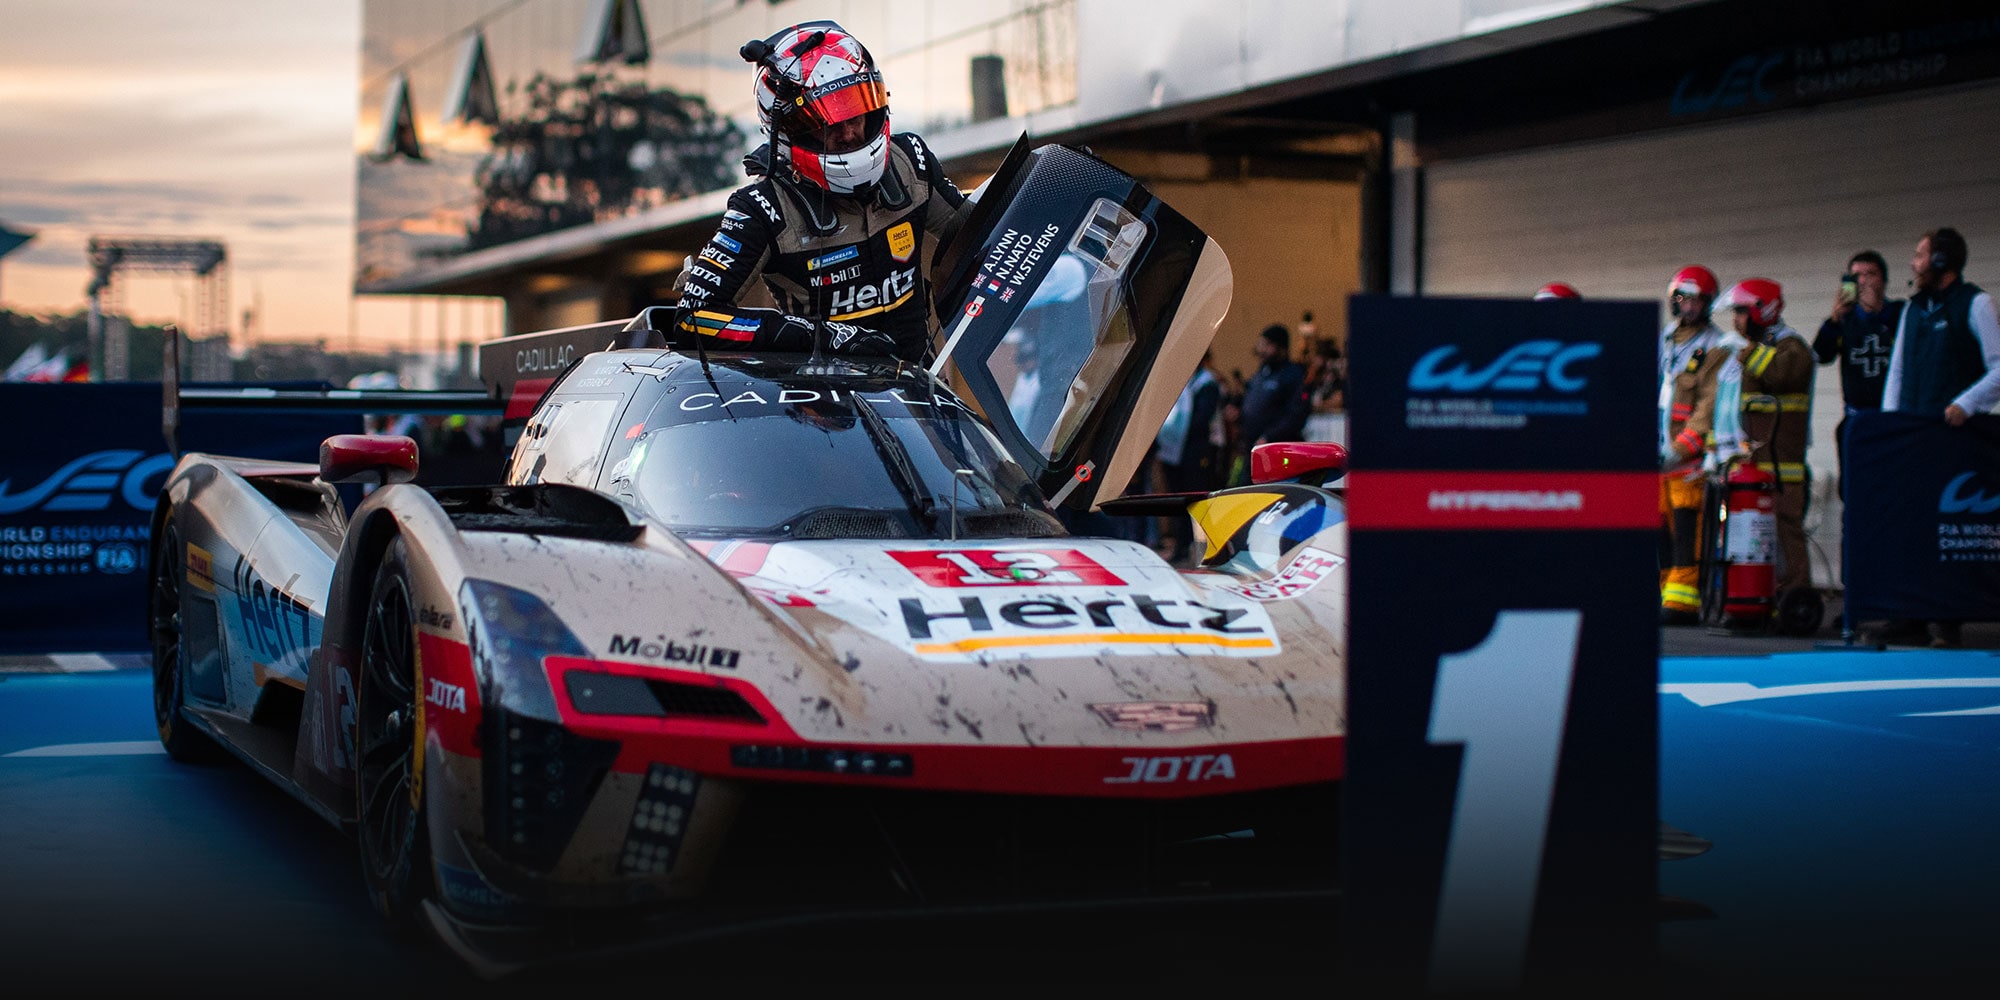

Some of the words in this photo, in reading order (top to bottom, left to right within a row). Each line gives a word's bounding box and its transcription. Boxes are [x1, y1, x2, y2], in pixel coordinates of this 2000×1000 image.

[812, 74, 868, 98] CADILLAC
[749, 189, 782, 223] HRX
[822, 249, 853, 264] MICHELIN
[984, 228, 1018, 272] A.LYNN
[996, 235, 1032, 280] N.NATO
[1010, 223, 1059, 285] W.STEVENS
[810, 270, 847, 287] Mobil
[829, 267, 916, 315] Hertz
[515, 344, 575, 373] CADILLAC
[1407, 340, 1602, 392] WEC
[0, 526, 46, 542] RLD
[0, 543, 92, 560] IONSHIP
[95, 549, 137, 569] FIA
[233, 554, 315, 675] Hertz
[898, 594, 1265, 639] Hertz
[608, 633, 708, 664] Mobil
[709, 647, 740, 669] 1
[426, 677, 467, 714] JOTA
[1103, 753, 1236, 784] JOTA
[1425, 609, 1583, 992] 1
